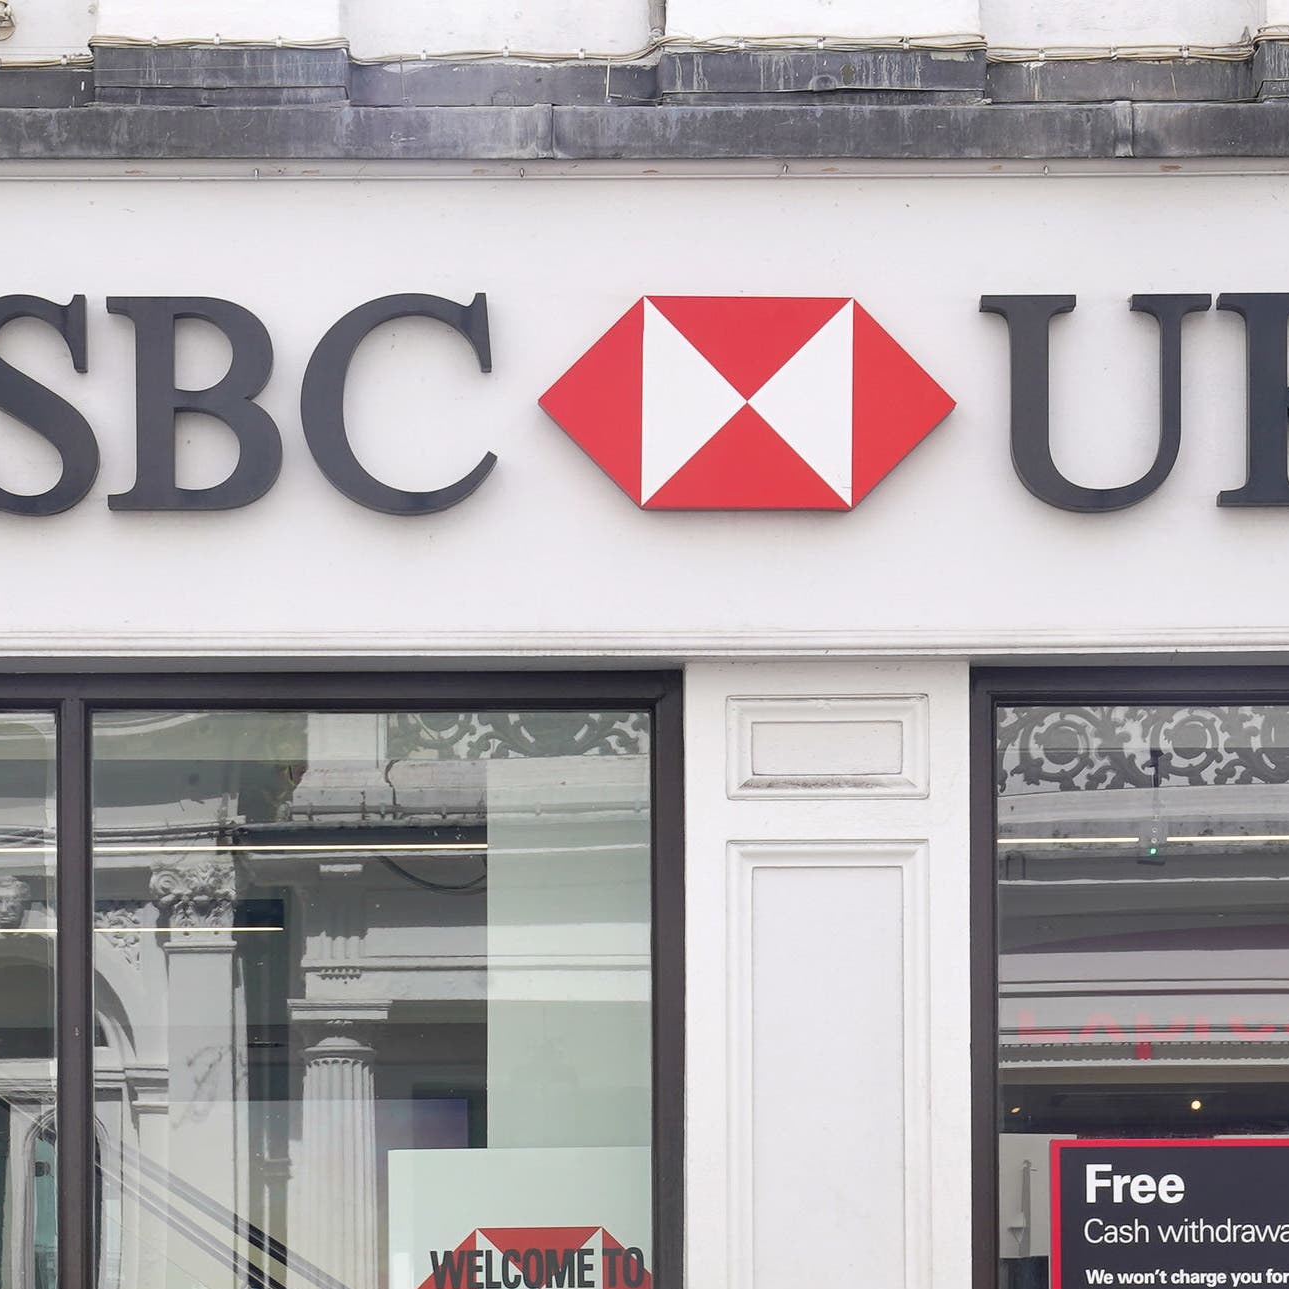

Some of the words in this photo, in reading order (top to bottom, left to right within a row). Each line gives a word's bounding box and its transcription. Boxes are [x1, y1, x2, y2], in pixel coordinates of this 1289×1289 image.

[1085, 1163, 1185, 1204] Free
[1083, 1218, 1149, 1245] Cash
[430, 1248, 595, 1289] WELCOME
[602, 1247, 644, 1289] TO
[1086, 1269, 1113, 1285] We
[1117, 1269, 1167, 1285] won't
[1171, 1269, 1227, 1289] charge
[1231, 1272, 1263, 1289] you
[1266, 1268, 1289, 1285] for
